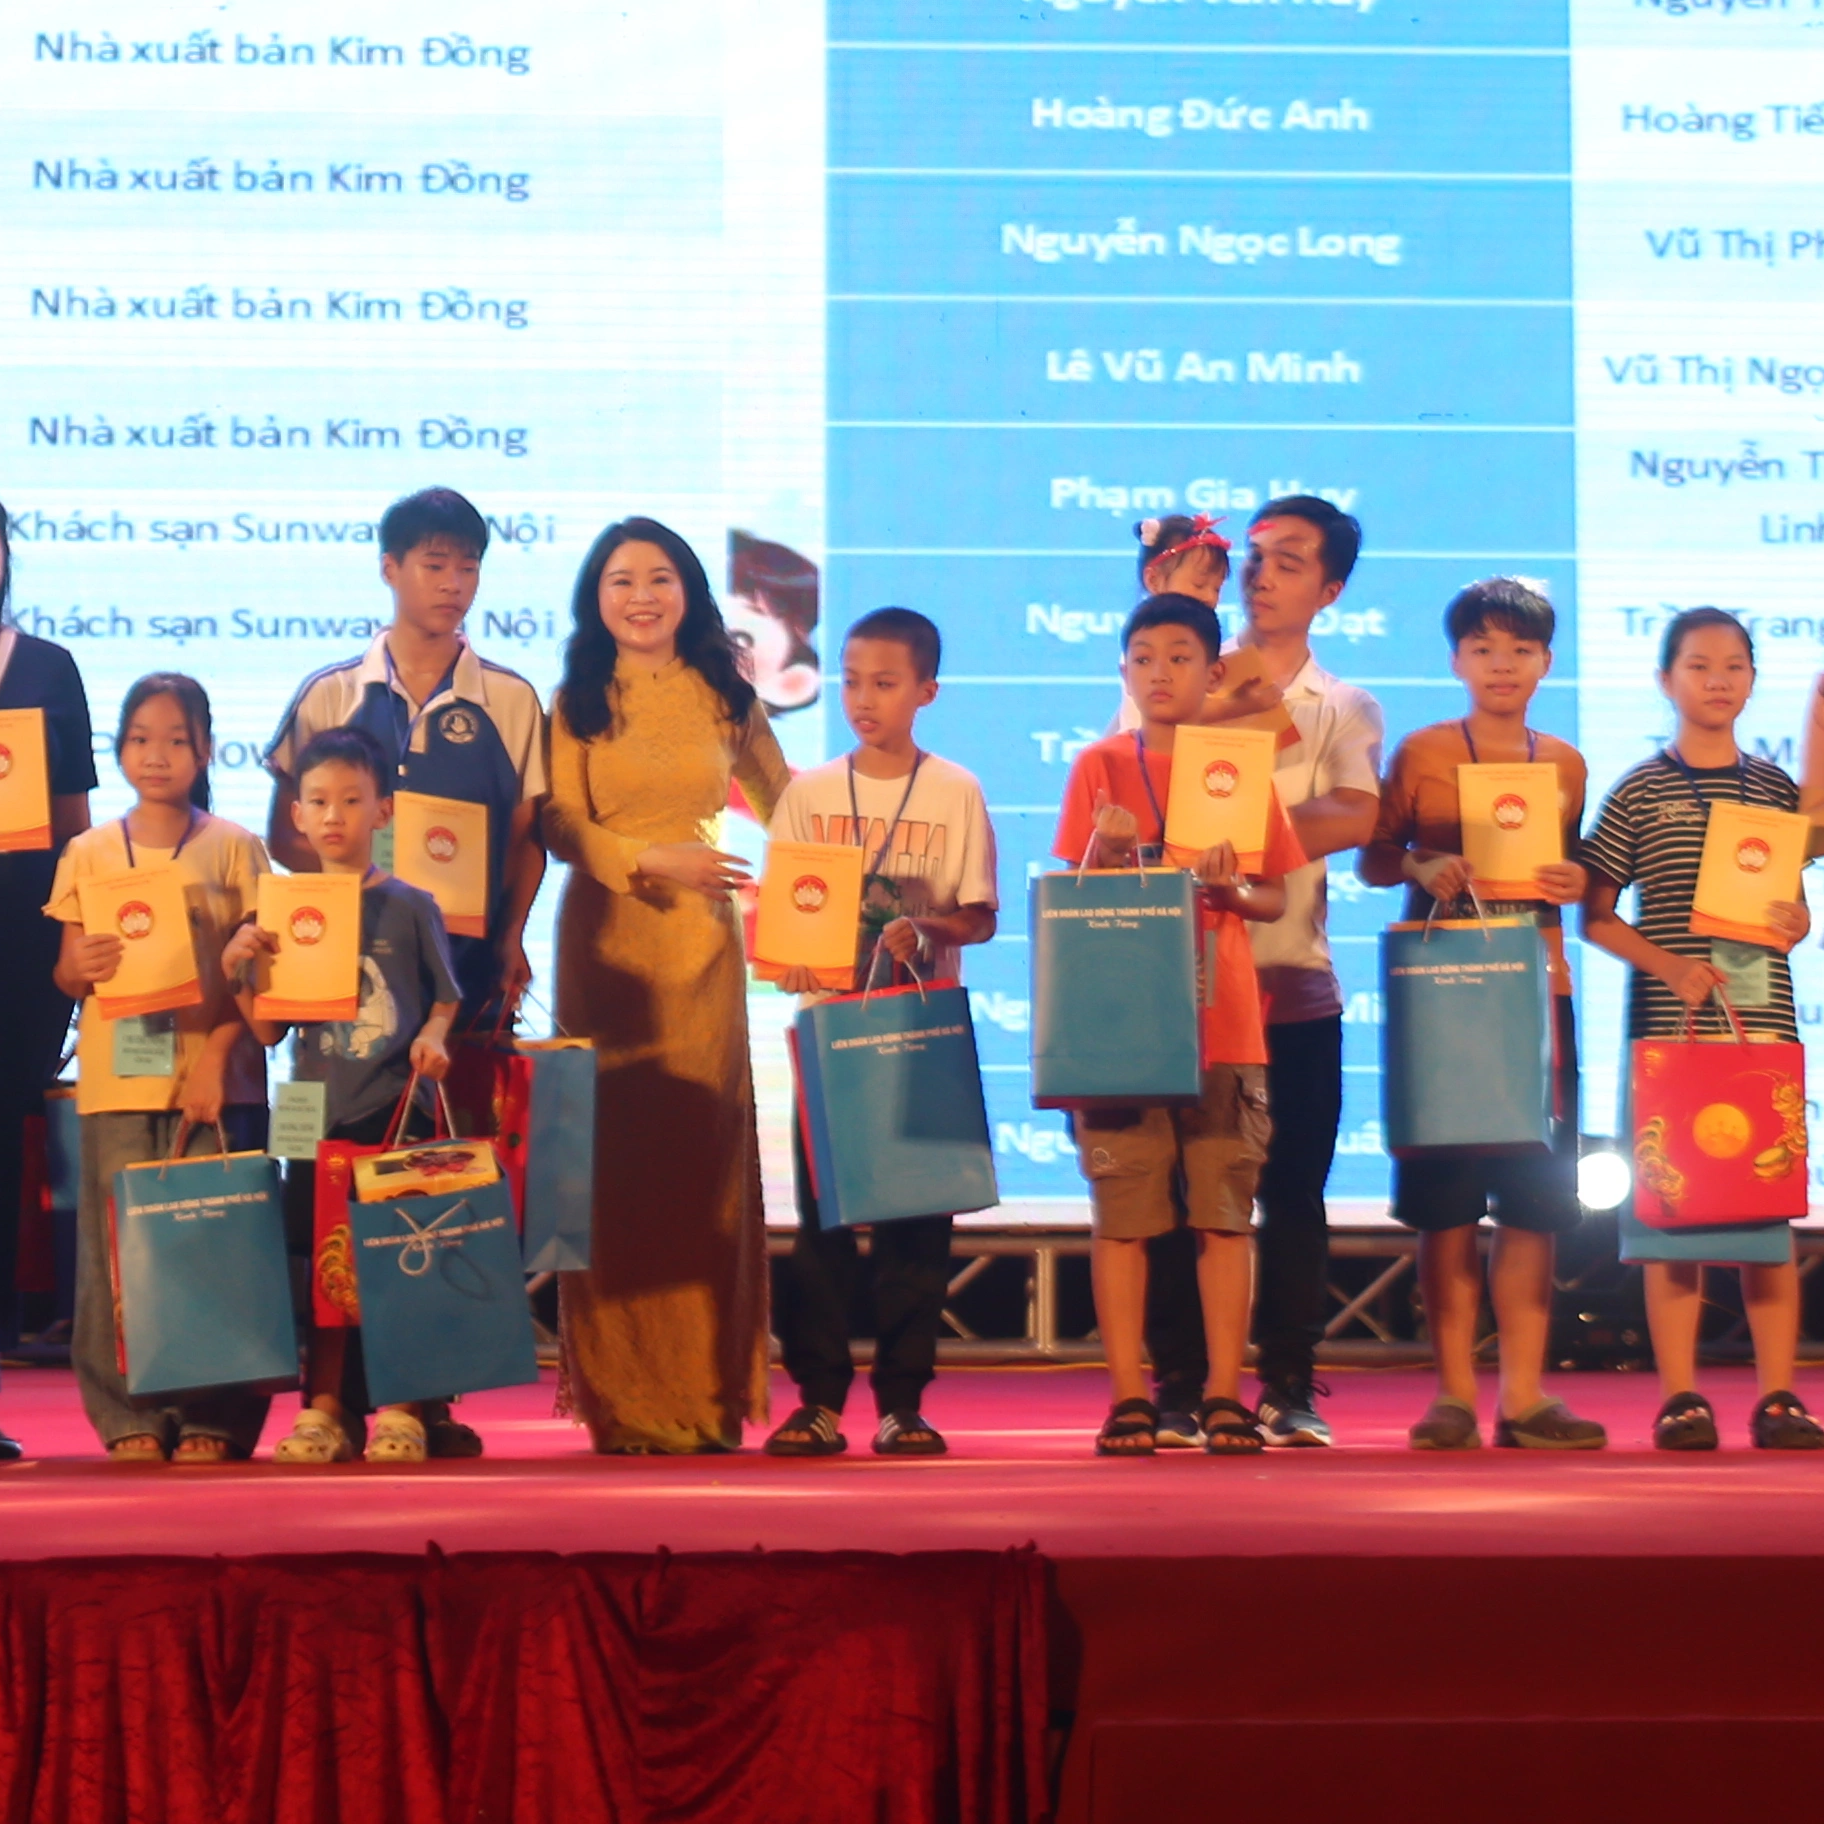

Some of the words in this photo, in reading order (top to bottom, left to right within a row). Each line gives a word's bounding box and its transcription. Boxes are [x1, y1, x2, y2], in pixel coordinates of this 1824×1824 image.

[1030, 94, 1174, 139] Hoàng
[1177, 96, 1273, 131] Đức
[1281, 97, 1371, 131] Anh
[1620, 100, 1760, 144] Hoàng
[1045, 347, 1095, 383] Lê
[1101, 348, 1165, 383] Vũ
[1175, 350, 1237, 383] An
[1247, 350, 1363, 384] Minh
[28, 413, 117, 449] Nhà
[124, 411, 219, 449] xuất
[229, 413, 312, 449] bản
[324, 417, 402, 450] Kim
[416, 414, 530, 460] Đồng
[1629, 438, 1789, 489] Nguyễn
